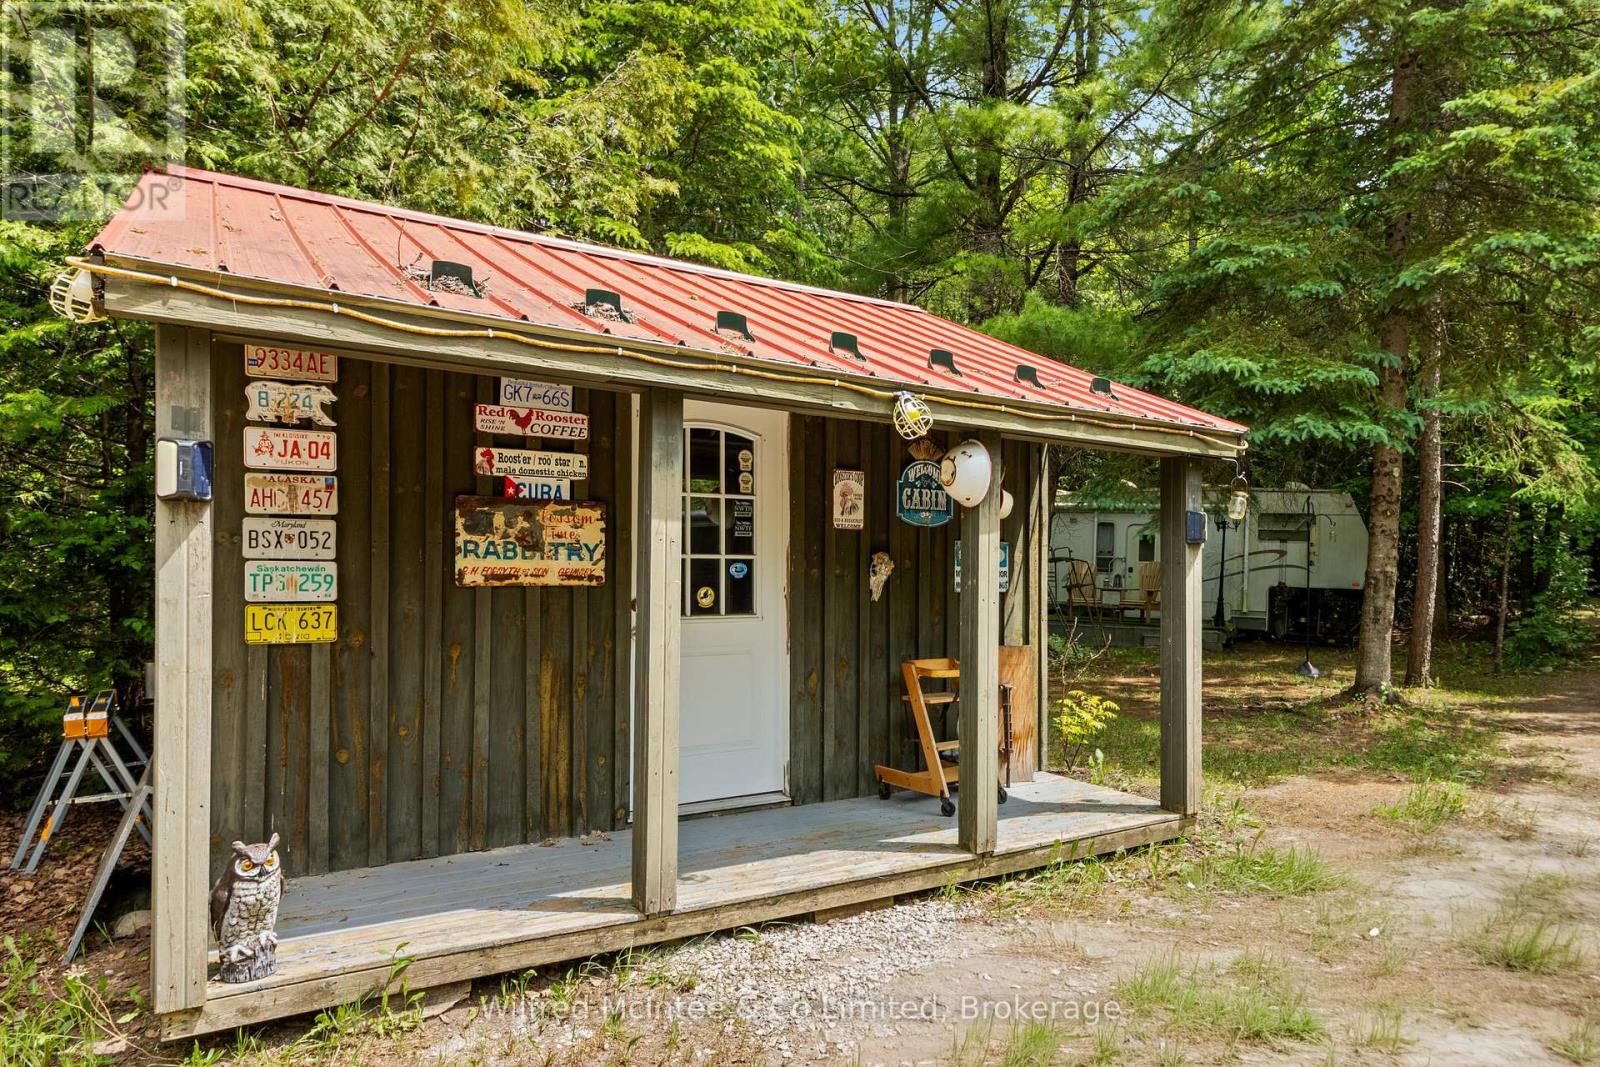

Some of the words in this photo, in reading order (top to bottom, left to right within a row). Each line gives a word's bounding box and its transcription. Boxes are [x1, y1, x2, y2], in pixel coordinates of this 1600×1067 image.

[478, 405, 505, 417] Red
[535, 411, 587, 425] Rooster
[530, 423, 587, 438] COFFEE
[495, 466, 516, 474] male
[518, 467, 555, 476] domestic
[556, 469, 587, 478] chicken
[908, 464, 941, 483] WELCOM
[268, 476, 316, 484] ALASKA
[516, 482, 563, 500] CUBA
[902, 488, 947, 511] CABIN
[271, 520, 307, 530] Maryland
[256, 564, 326, 572] Saskatchewan
